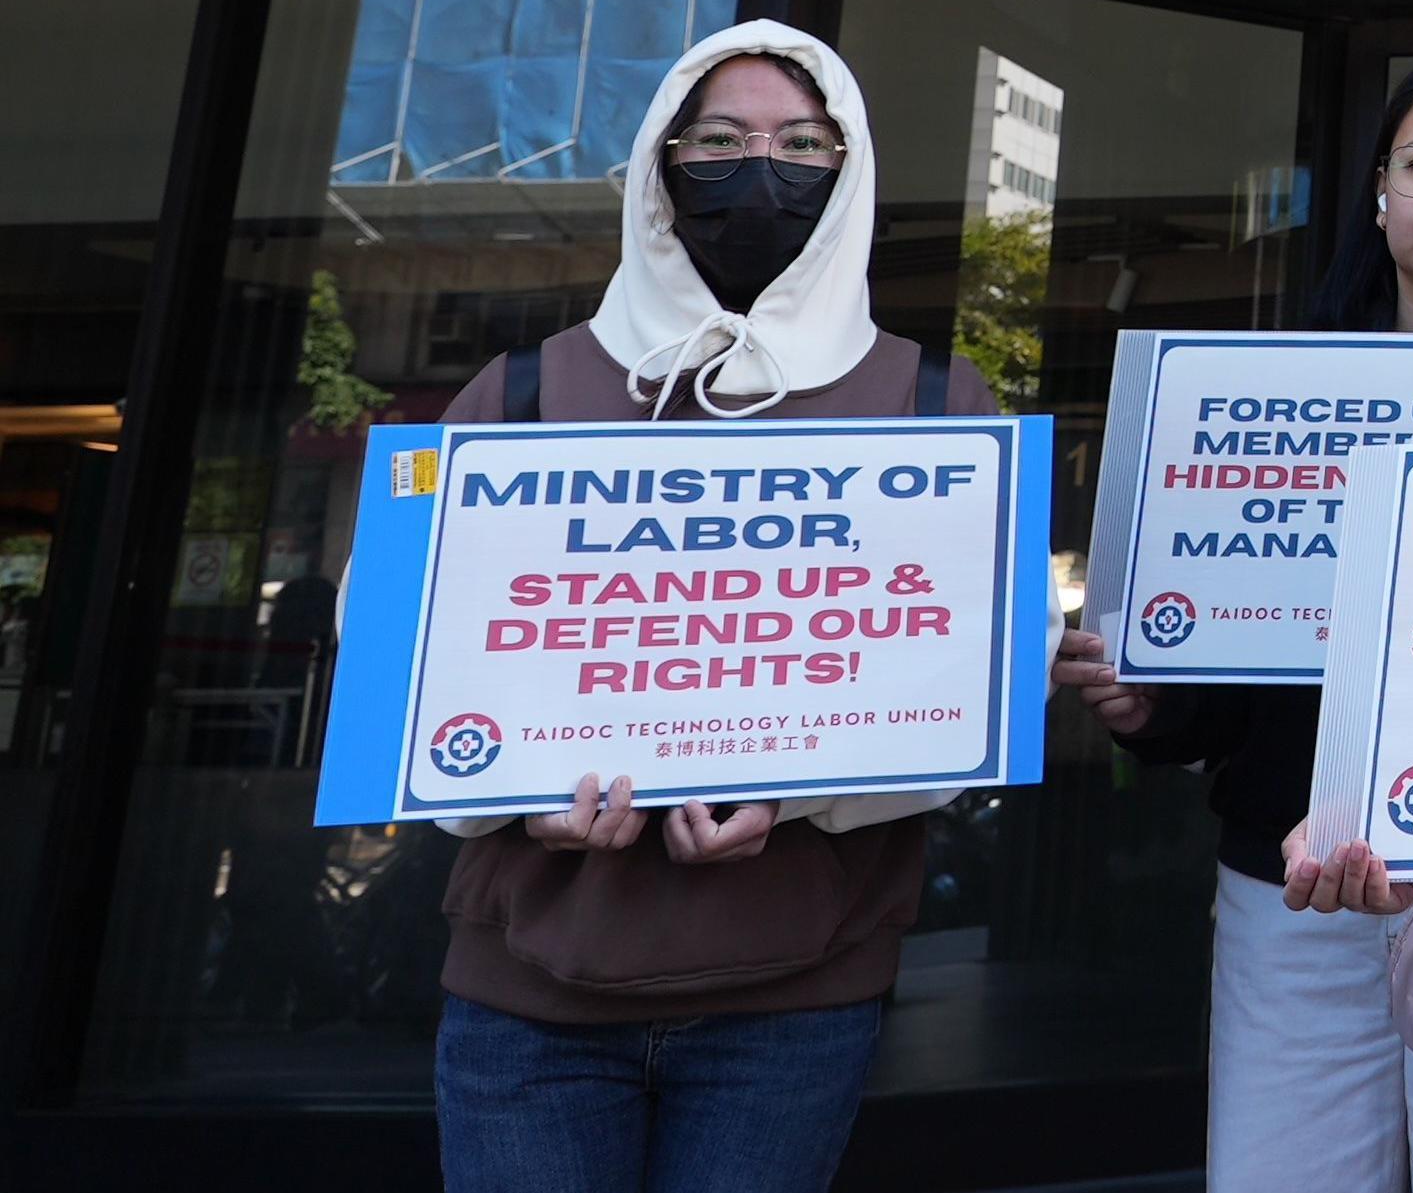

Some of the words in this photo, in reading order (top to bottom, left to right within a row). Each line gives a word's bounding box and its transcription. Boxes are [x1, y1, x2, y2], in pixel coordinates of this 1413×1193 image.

[1198, 397, 1402, 424] FORCED
[460, 466, 863, 508] MINISTRY
[878, 464, 976, 499] OF
[1241, 498, 1307, 524] OF
[565, 513, 860, 553] LABOR,
[508, 569, 762, 607] STAND
[777, 566, 871, 599] UP
[885, 563, 936, 596] &
[484, 611, 794, 652] DEFEND
[808, 605, 952, 641] OUR
[1210, 607, 1282, 621] TAIDOC
[577, 651, 861, 695] RIGHTS!
[521, 724, 613, 742] TAIDOC
[625, 715, 790, 737] TECHNOLOGY
[801, 711, 876, 728] LABOR
[888, 707, 962, 725] UNION
[655, 734, 820, 760] 泰博科技企業工會
